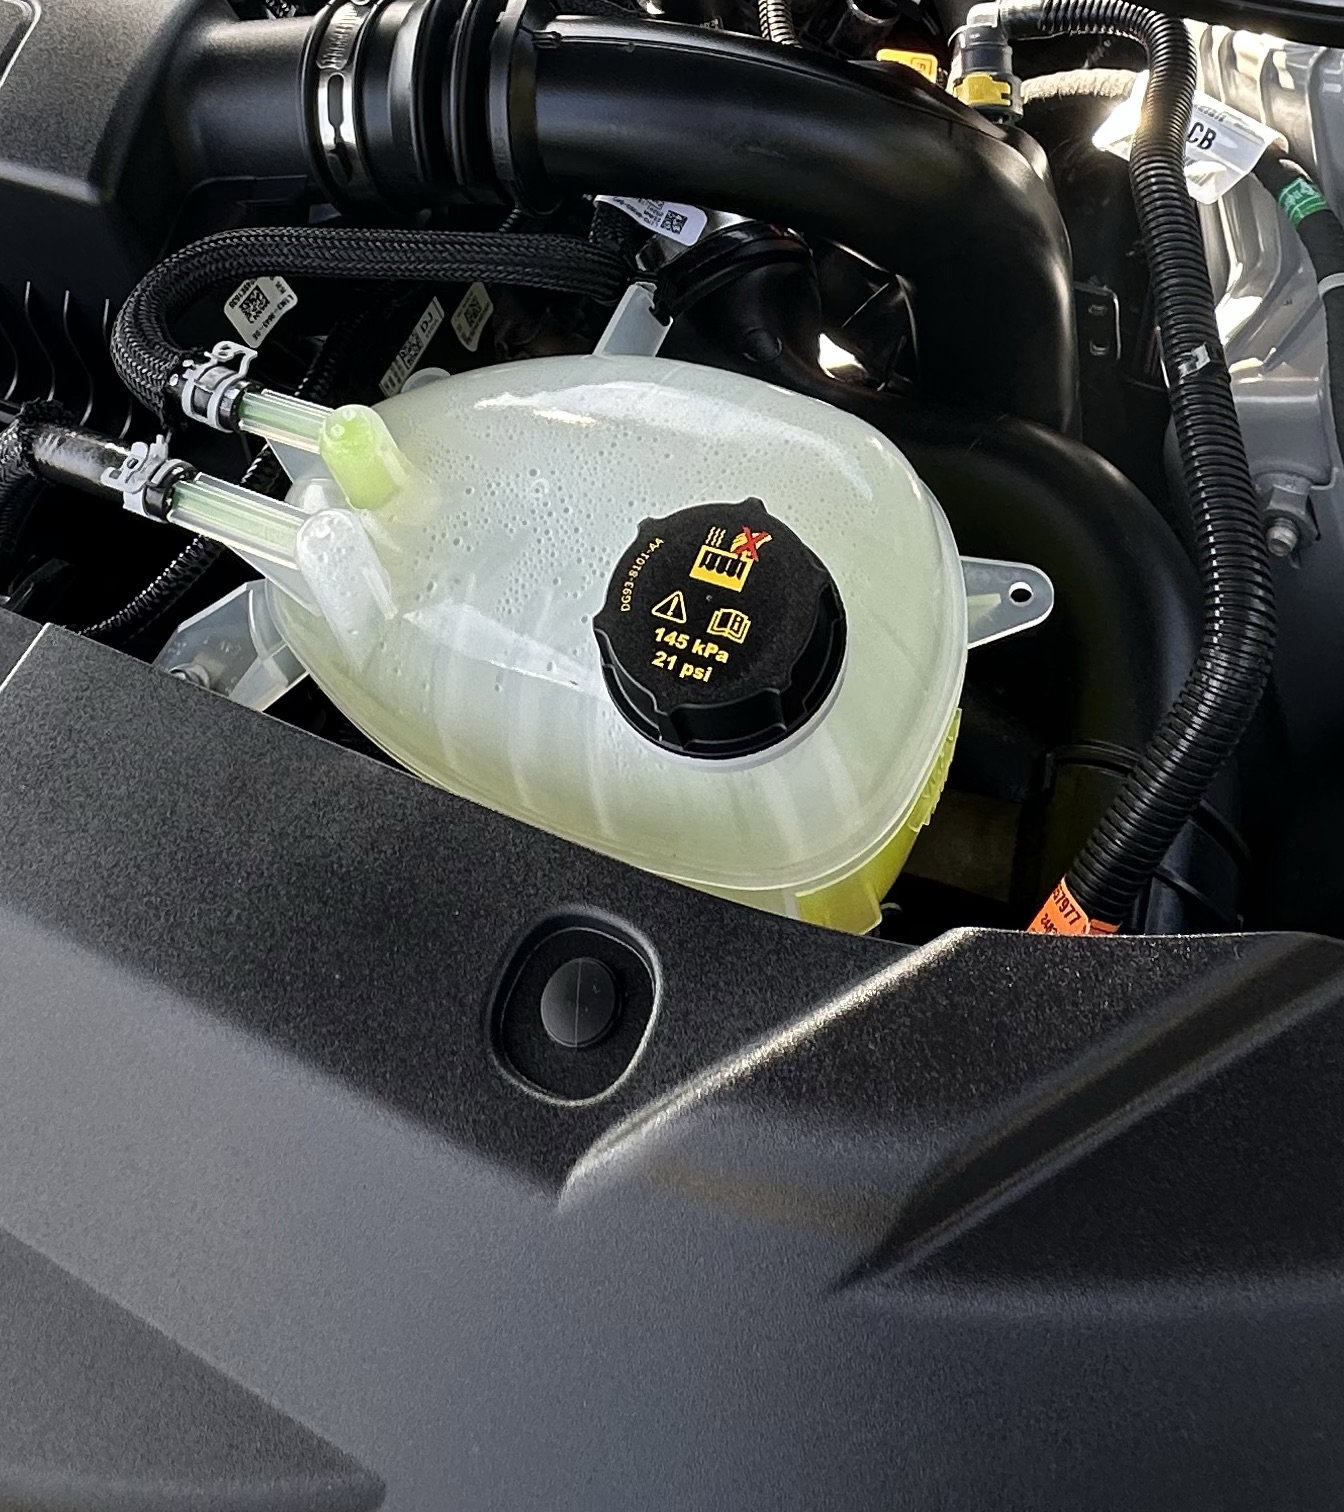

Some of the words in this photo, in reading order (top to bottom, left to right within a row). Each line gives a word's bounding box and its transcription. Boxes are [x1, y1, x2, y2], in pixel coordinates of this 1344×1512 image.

[620, 536, 665, 613] DG93-8101-AA
[654, 626, 688, 650] 145
[691, 638, 730, 664] kPa
[651, 651, 674, 671] 21
[680, 662, 713, 684] psi
